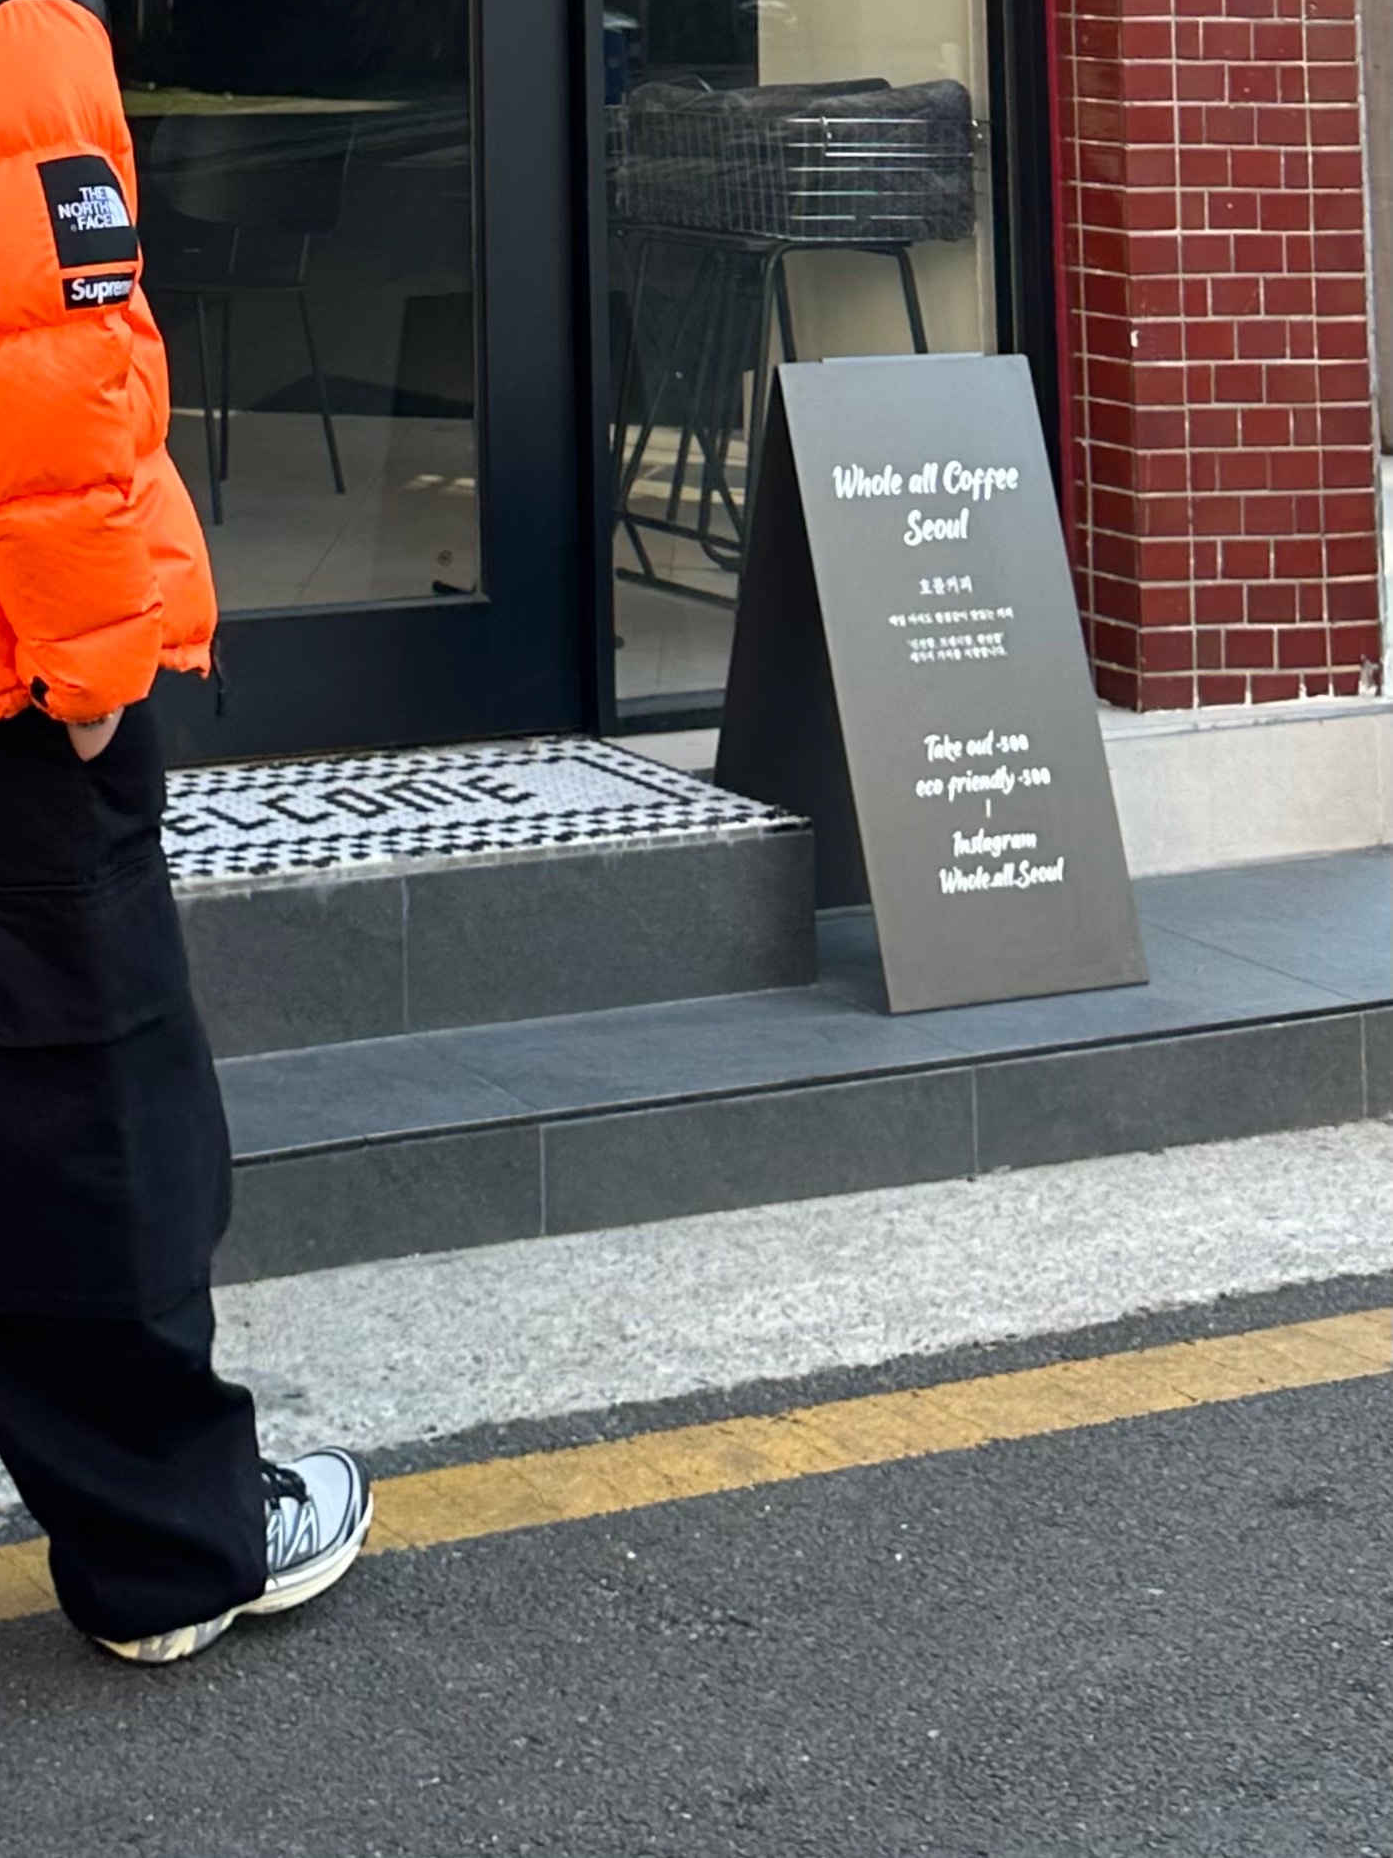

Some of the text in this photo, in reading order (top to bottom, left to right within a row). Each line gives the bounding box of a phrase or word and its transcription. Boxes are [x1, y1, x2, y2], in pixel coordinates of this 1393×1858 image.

[58, 201, 113, 219] NORTH
[78, 186, 108, 203] THE
[76, 214, 113, 231] FACE
[832, 460, 1019, 502] Whole all Coffee
[903, 507, 970, 546] Seoul
[923, 728, 1029, 762] Take out -500
[915, 764, 1051, 802] eco friendly -500
[160, 773, 534, 837] ELCOME
[952, 827, 1037, 858] Instagram
